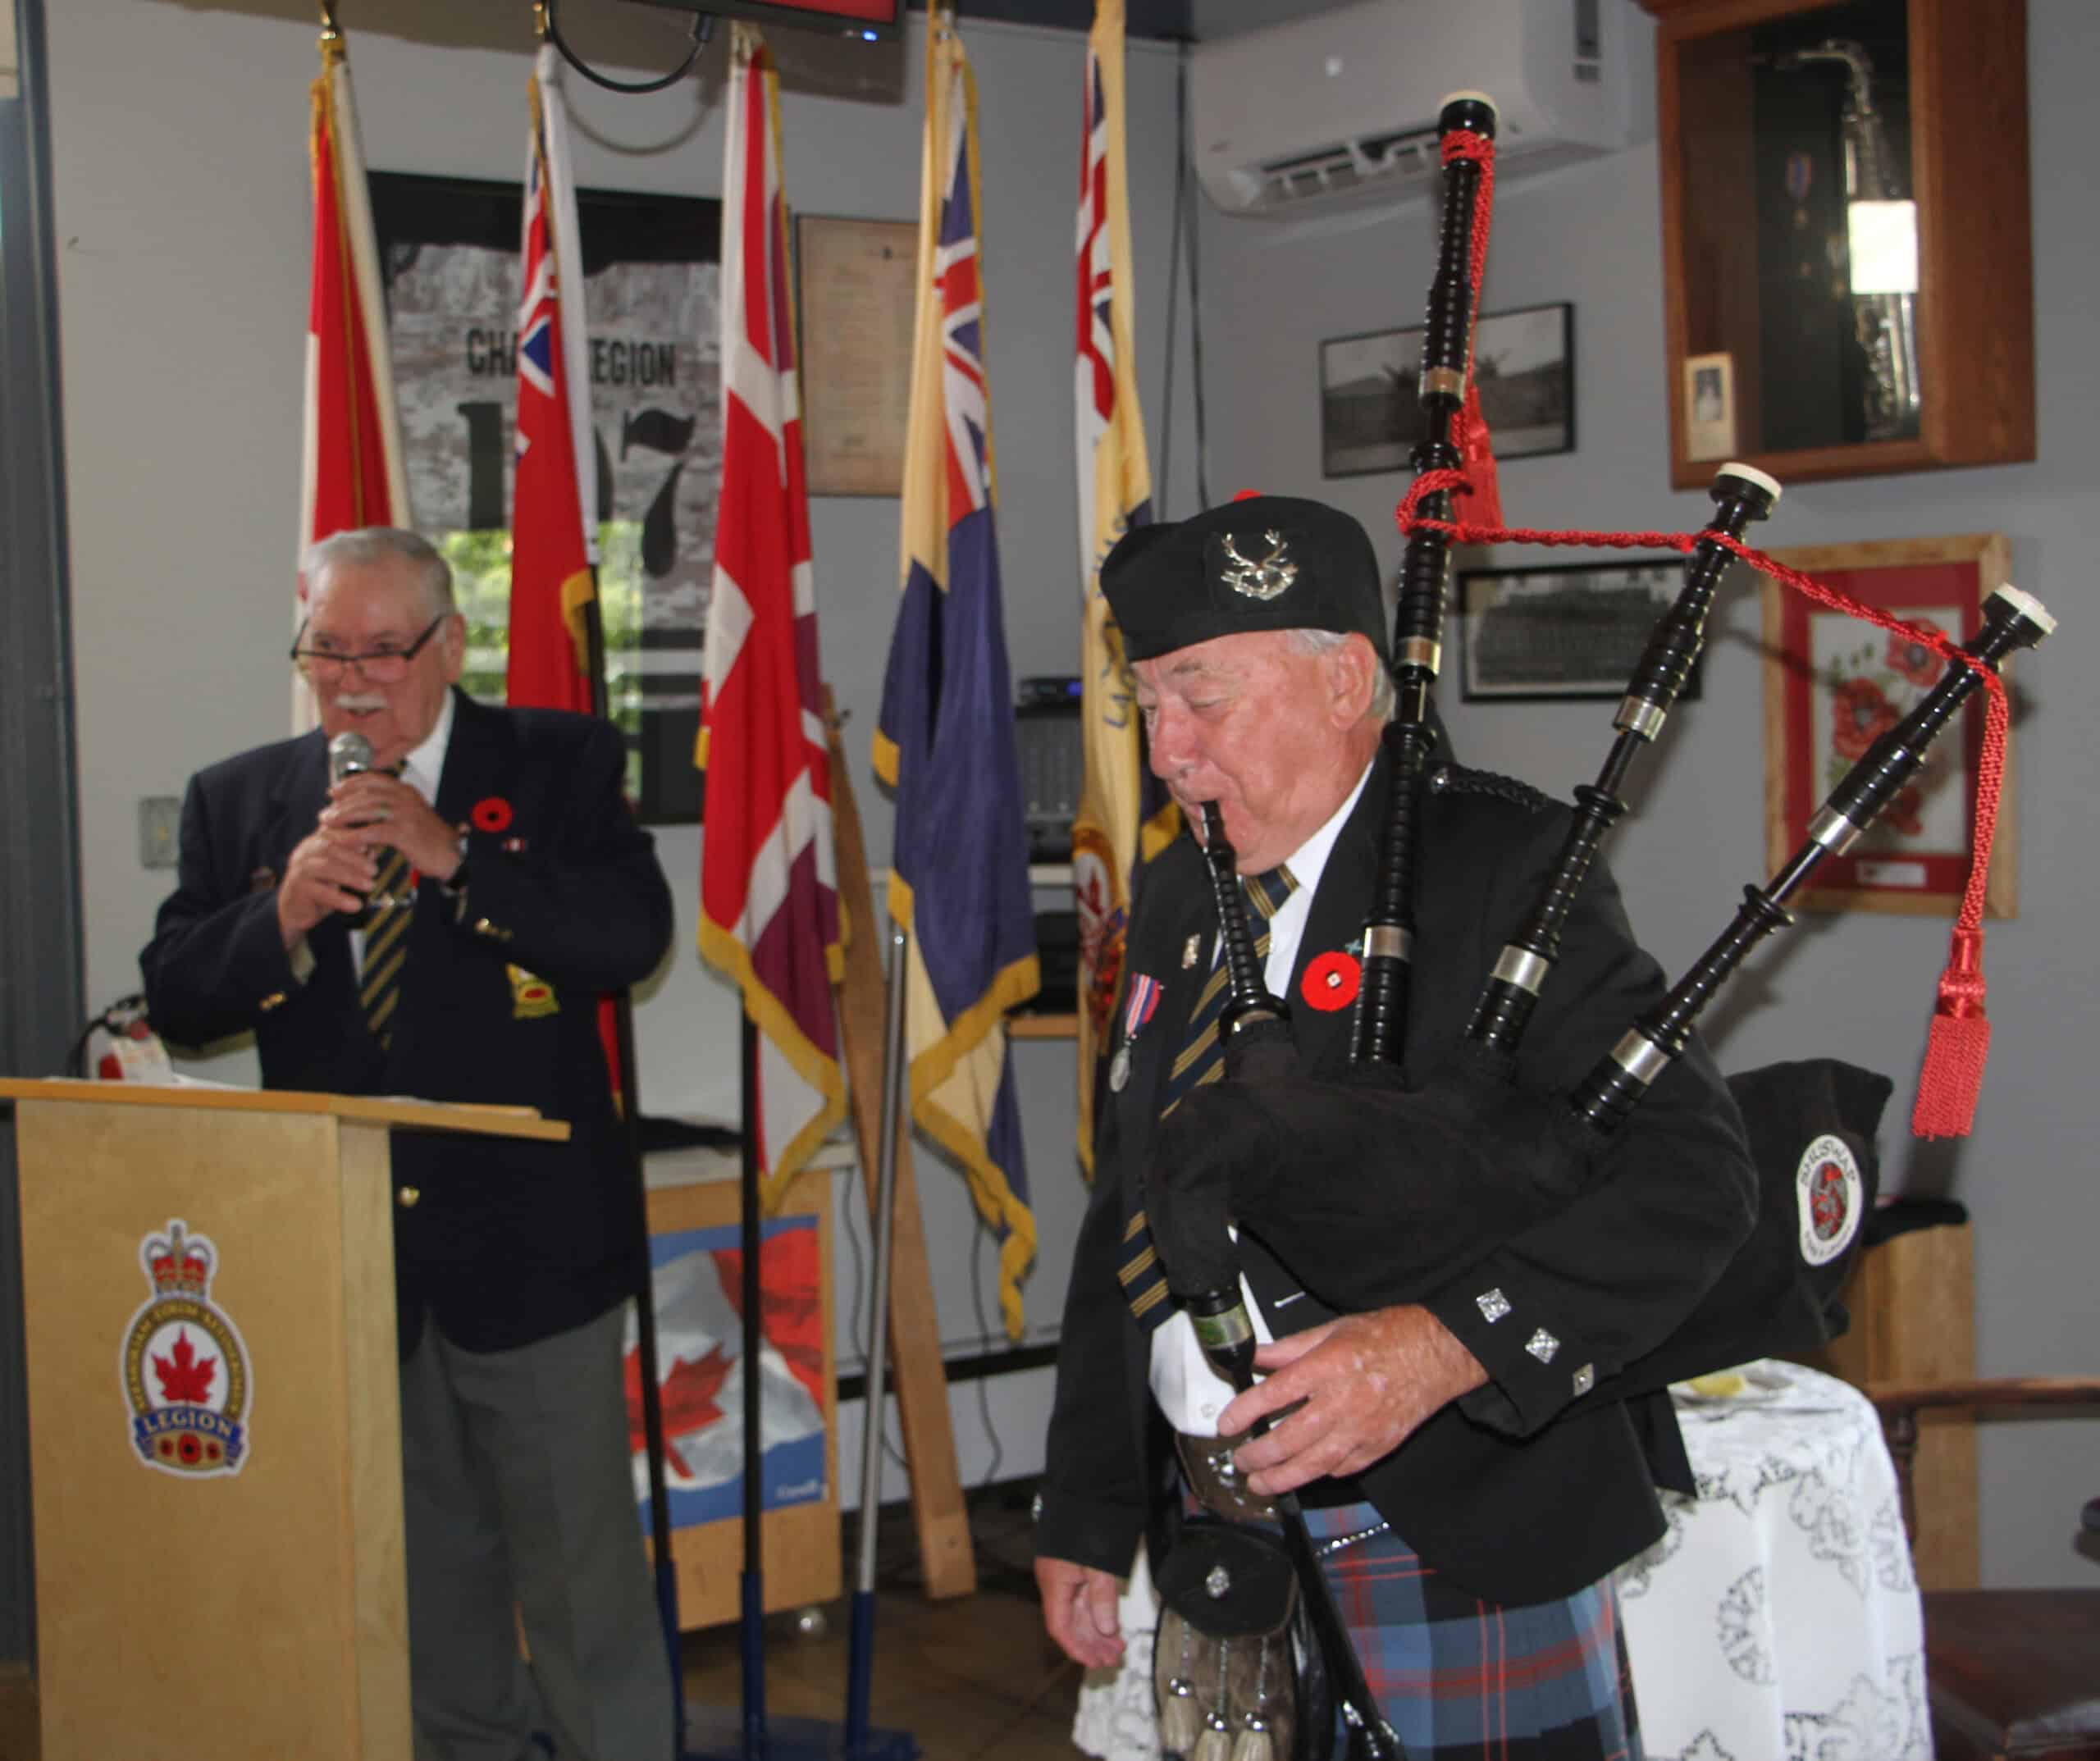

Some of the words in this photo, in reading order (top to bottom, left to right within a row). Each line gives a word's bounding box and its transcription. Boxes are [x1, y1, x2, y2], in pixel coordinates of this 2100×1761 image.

[588, 337, 676, 386] EGION
[456, 402, 695, 579] 17
[144, 1410, 232, 1435] LEGION
